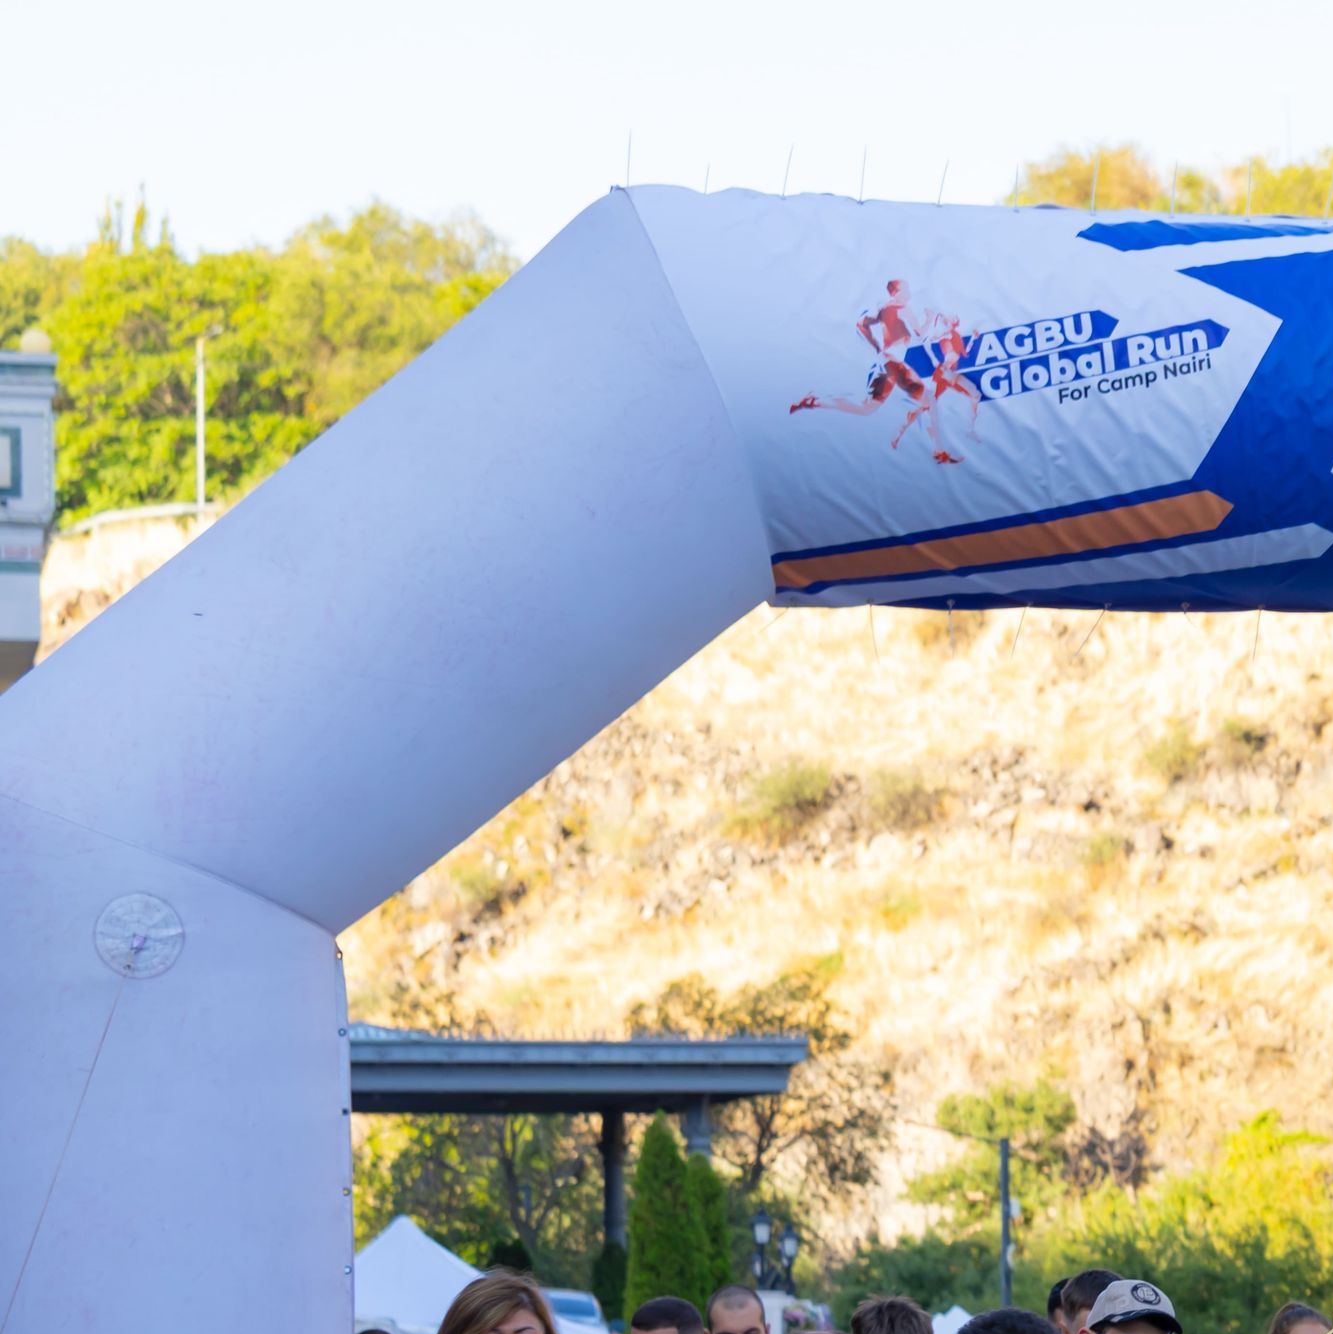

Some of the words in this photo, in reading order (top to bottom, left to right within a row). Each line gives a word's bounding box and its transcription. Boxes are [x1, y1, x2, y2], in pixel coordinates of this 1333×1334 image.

[975, 312, 1093, 367] AGBU
[980, 341, 1116, 400] Global
[1126, 327, 1209, 368] Run
[1058, 384, 1091, 404] For
[1097, 370, 1157, 394] Camp
[1162, 353, 1213, 380] Nairi
